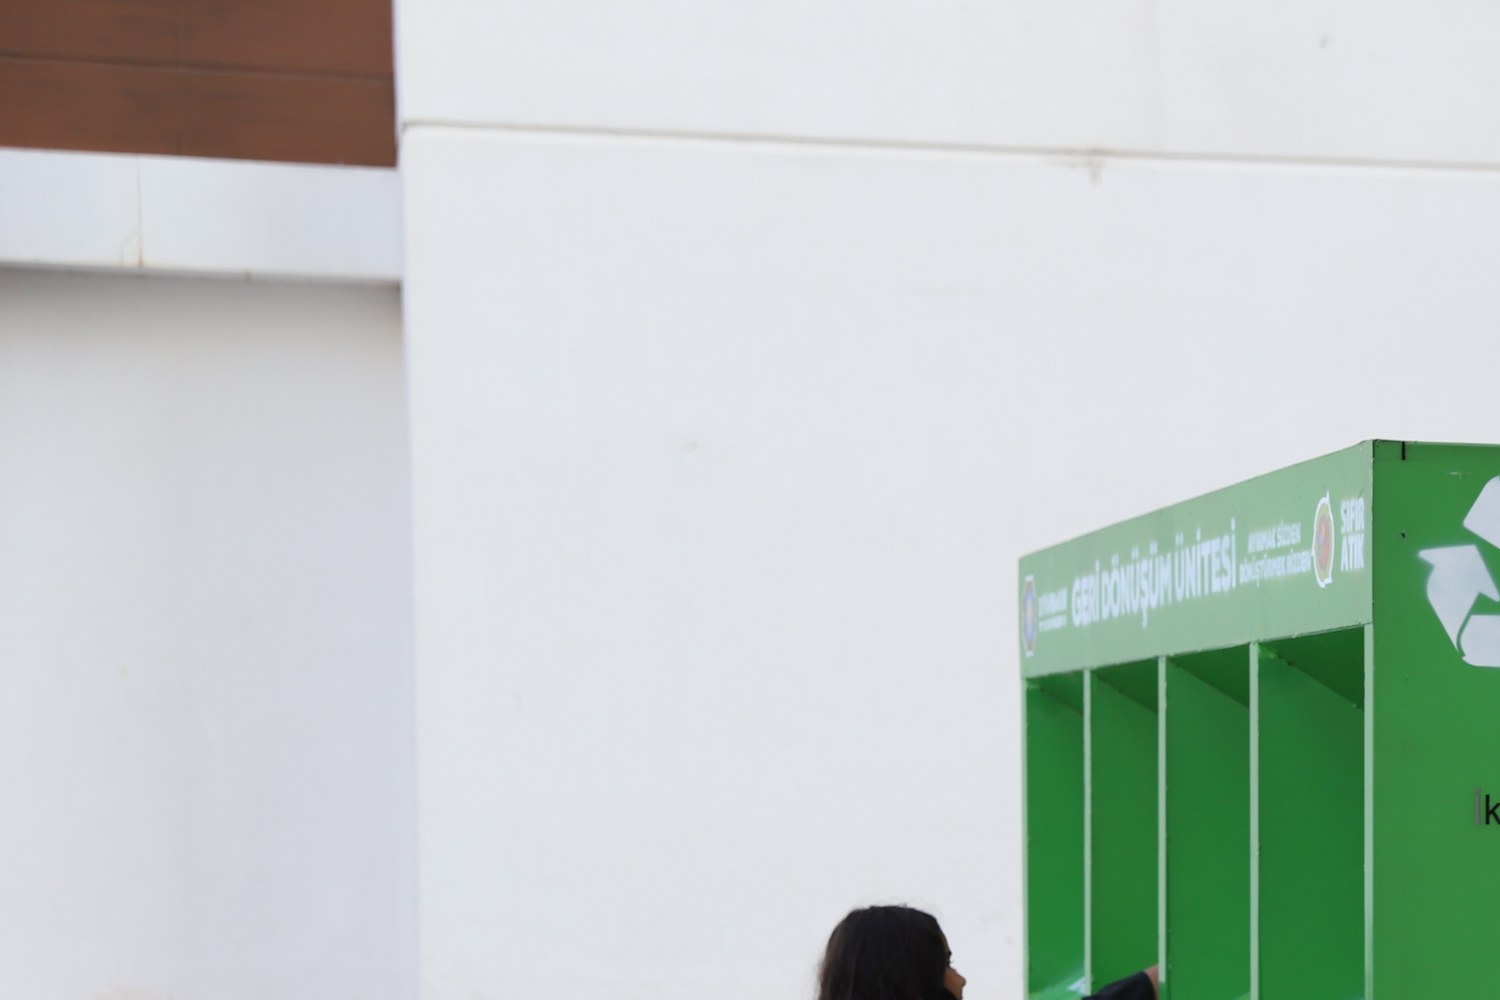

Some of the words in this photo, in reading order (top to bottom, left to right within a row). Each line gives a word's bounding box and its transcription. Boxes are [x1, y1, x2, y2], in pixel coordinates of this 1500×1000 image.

[1341, 496, 1364, 533] SIFIR
[1341, 533, 1364, 571] ATIK
[1072, 556, 1100, 627] GERİ
[1101, 541, 1172, 628] DÖNÜŞÜM
[1174, 517, 1236, 602] ÜNİTESİ
